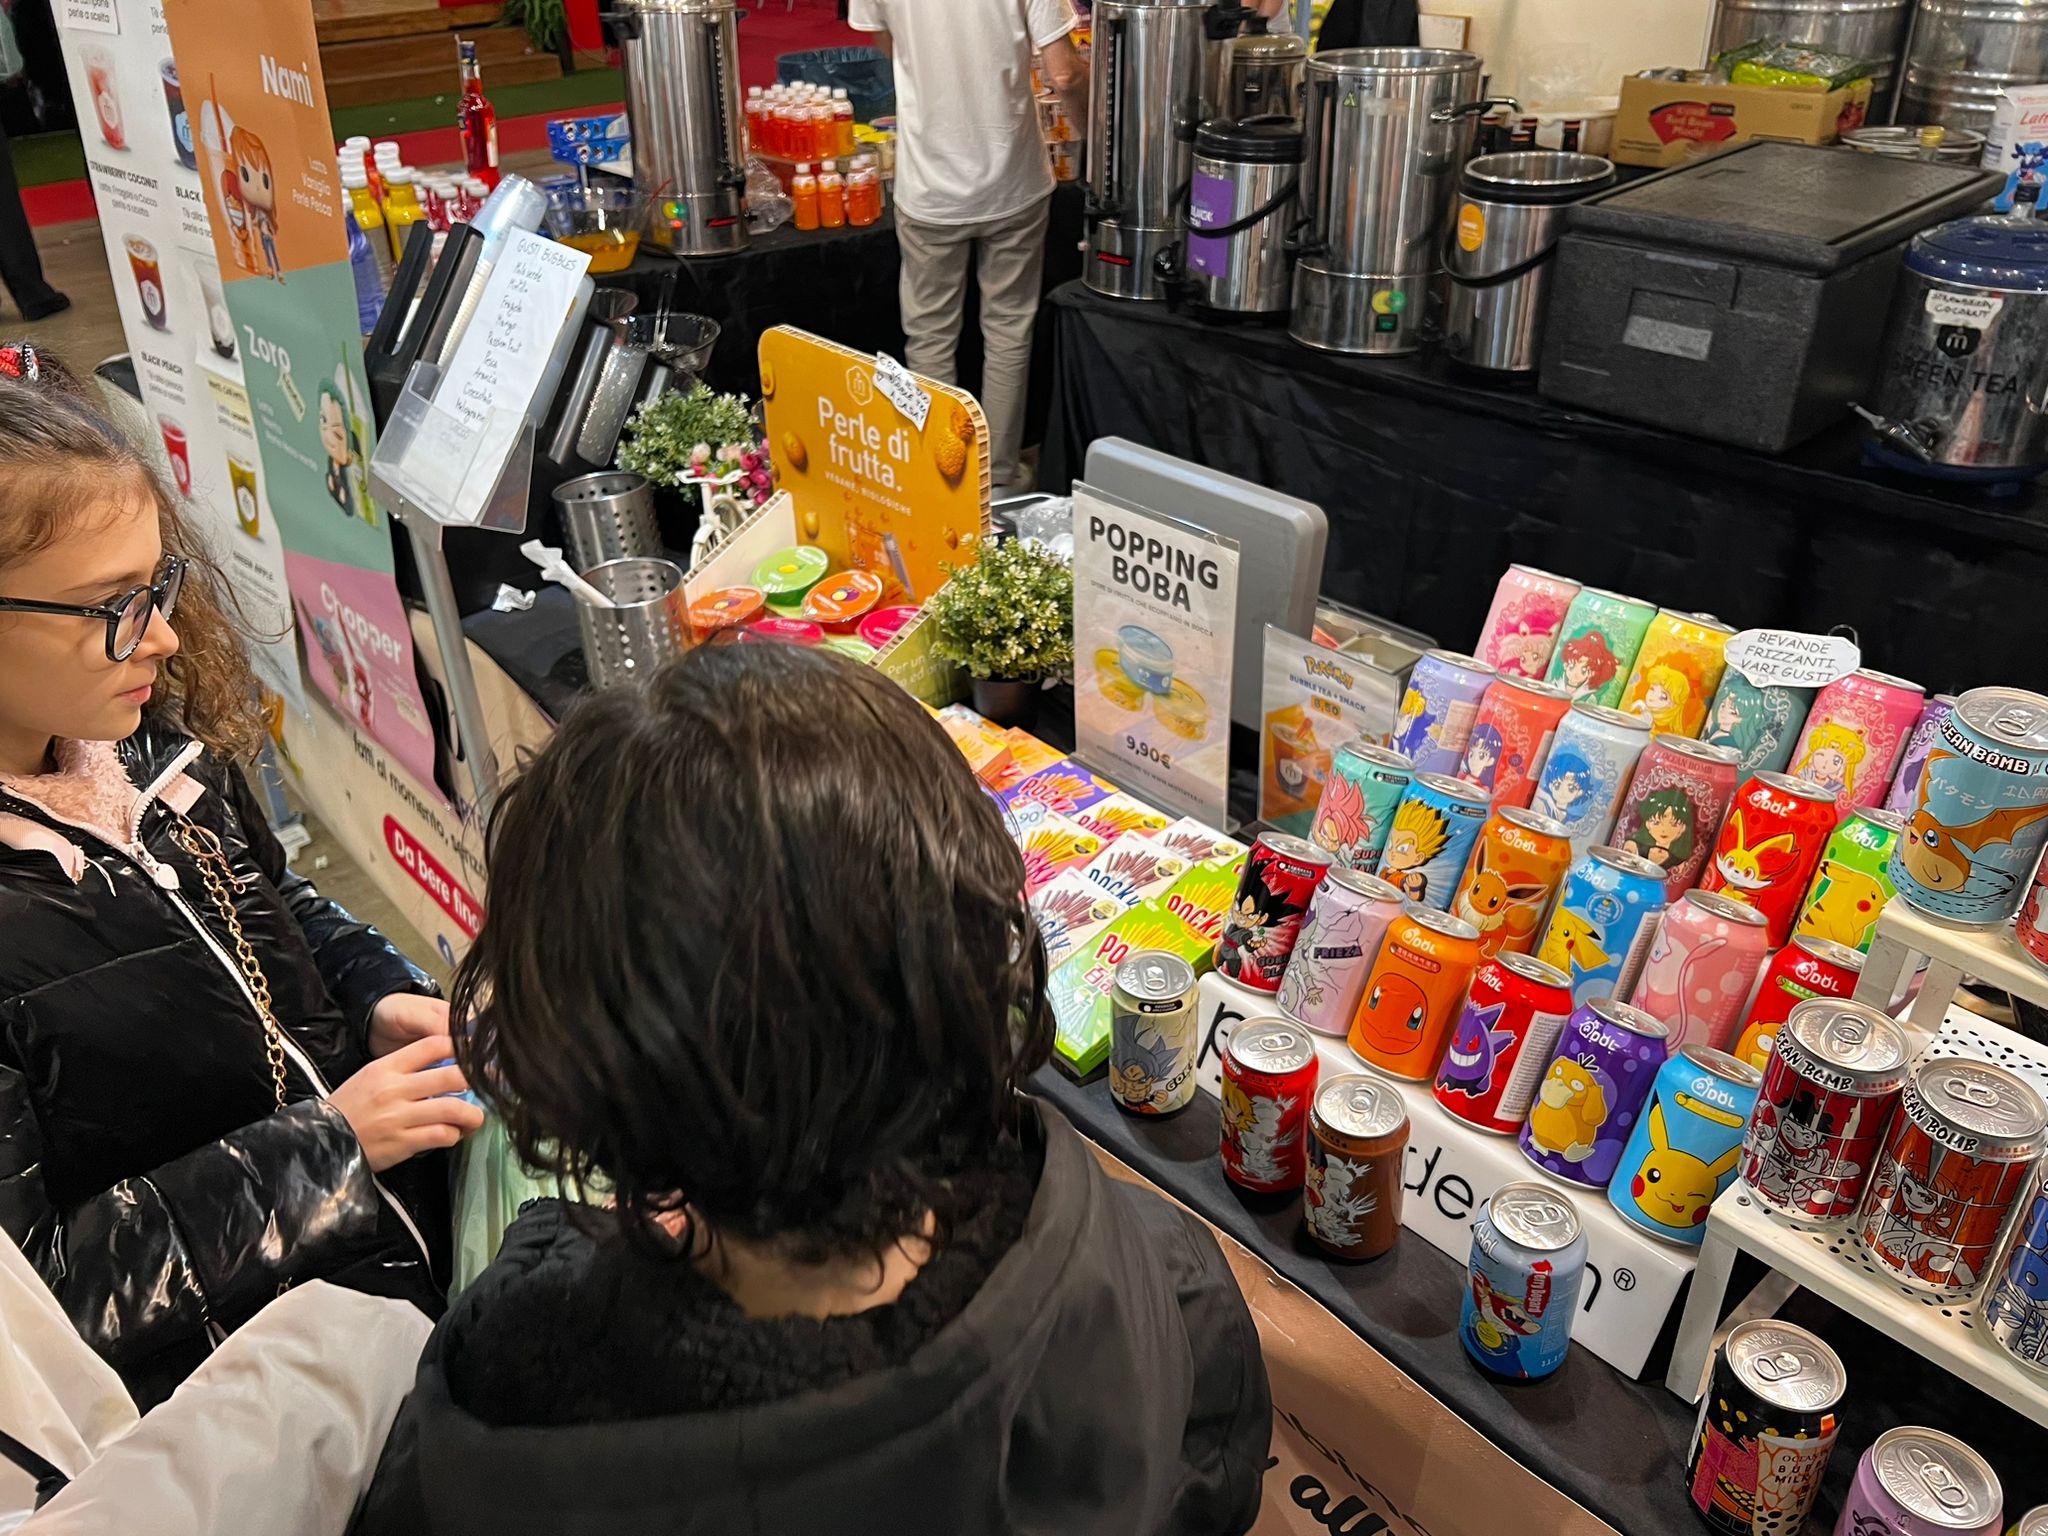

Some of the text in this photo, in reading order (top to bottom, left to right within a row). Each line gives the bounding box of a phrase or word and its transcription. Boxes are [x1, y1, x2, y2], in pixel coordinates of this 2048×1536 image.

[260, 54, 314, 108] Nami
[175, 186, 201, 202] BLACK
[243, 324, 292, 373] Zoro
[1971, 371, 2018, 394] TEA
[818, 396, 910, 464] Perle di
[829, 434, 903, 492] frutta.
[1090, 516, 1218, 590] POPPING
[1113, 555, 1191, 613] BOBA
[320, 582, 402, 664] Chopper
[1744, 645, 1835, 669] FRIZZANTI
[1758, 632, 1831, 655] BEVANDE
[1740, 659, 1833, 683] VARI GUSTI
[1289, 673, 1317, 691] BUBBLE
[1317, 686, 1332, 699] TEA
[1339, 695, 1366, 713] SNACK
[1126, 735, 1171, 770] 9,90€
[1972, 746, 2028, 774] BOMB
[1019, 778, 1077, 812] POCKY
[393, 828, 416, 868] Da
[418, 852, 450, 904] bere
[1313, 945, 1363, 959] FRIEZA
[1802, 1060, 1853, 1091] BOMB
[1775, 1475, 1810, 1484] MILK
